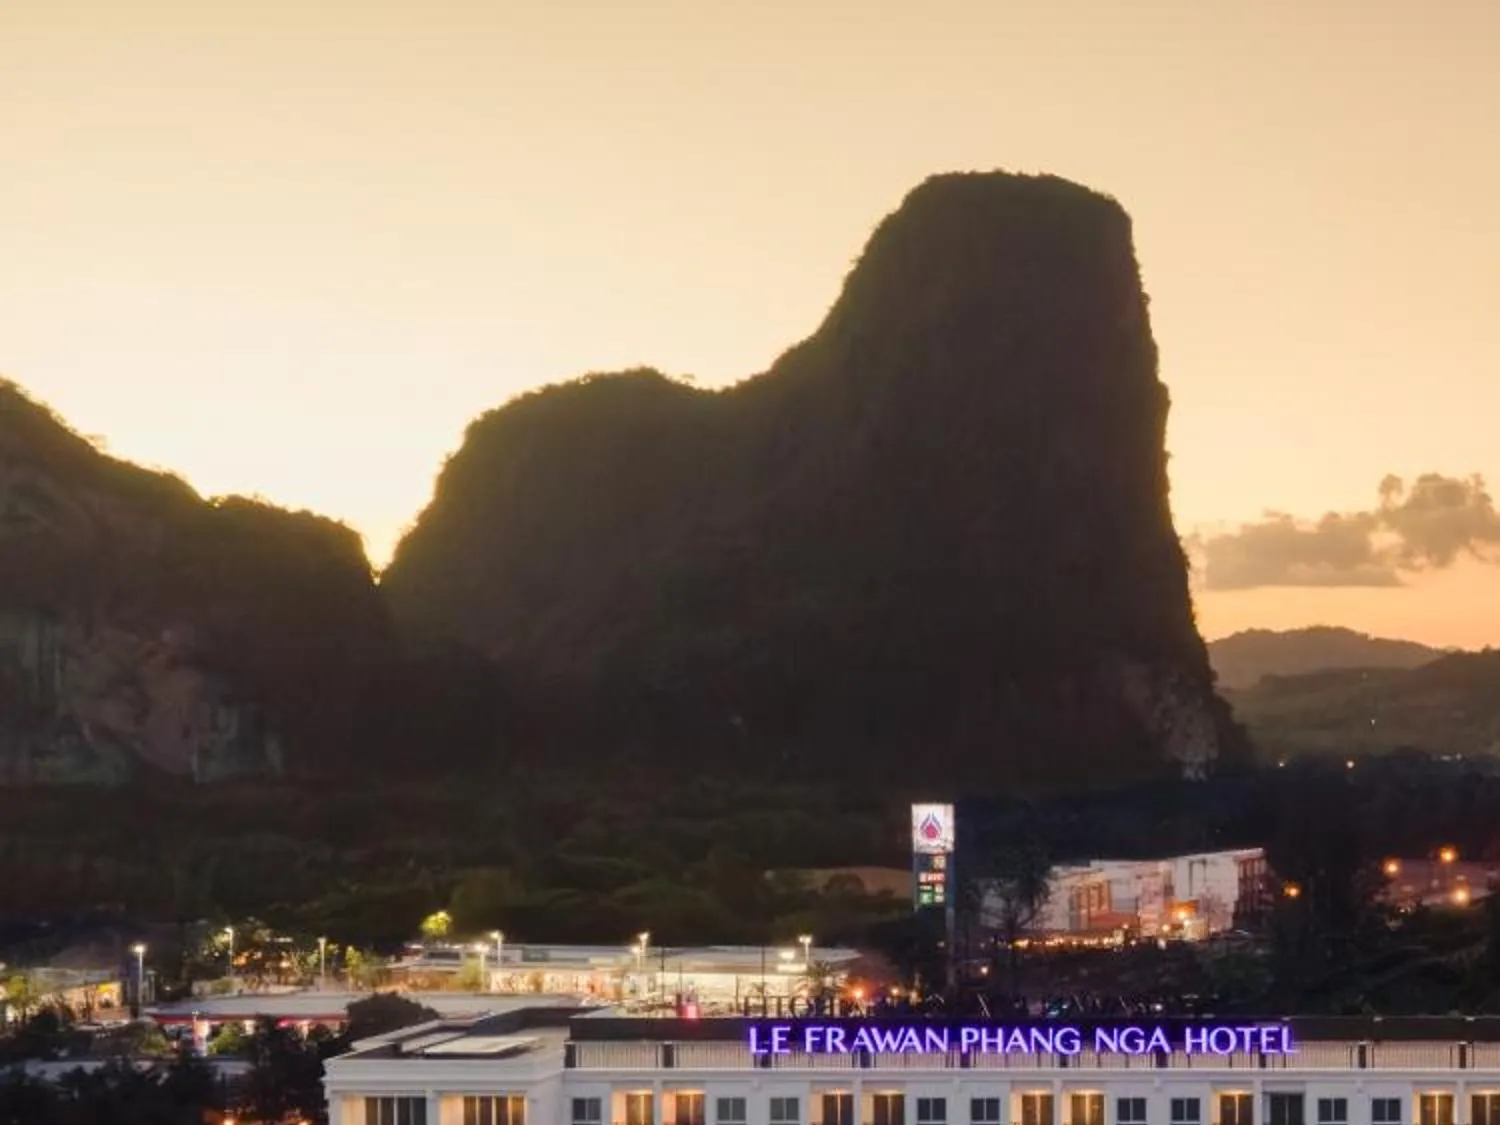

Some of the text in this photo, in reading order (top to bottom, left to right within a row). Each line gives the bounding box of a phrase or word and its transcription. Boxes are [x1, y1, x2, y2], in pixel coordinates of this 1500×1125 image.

[749, 1026, 1295, 1055] LE FRAWAN PHANG NGA HOTEL
